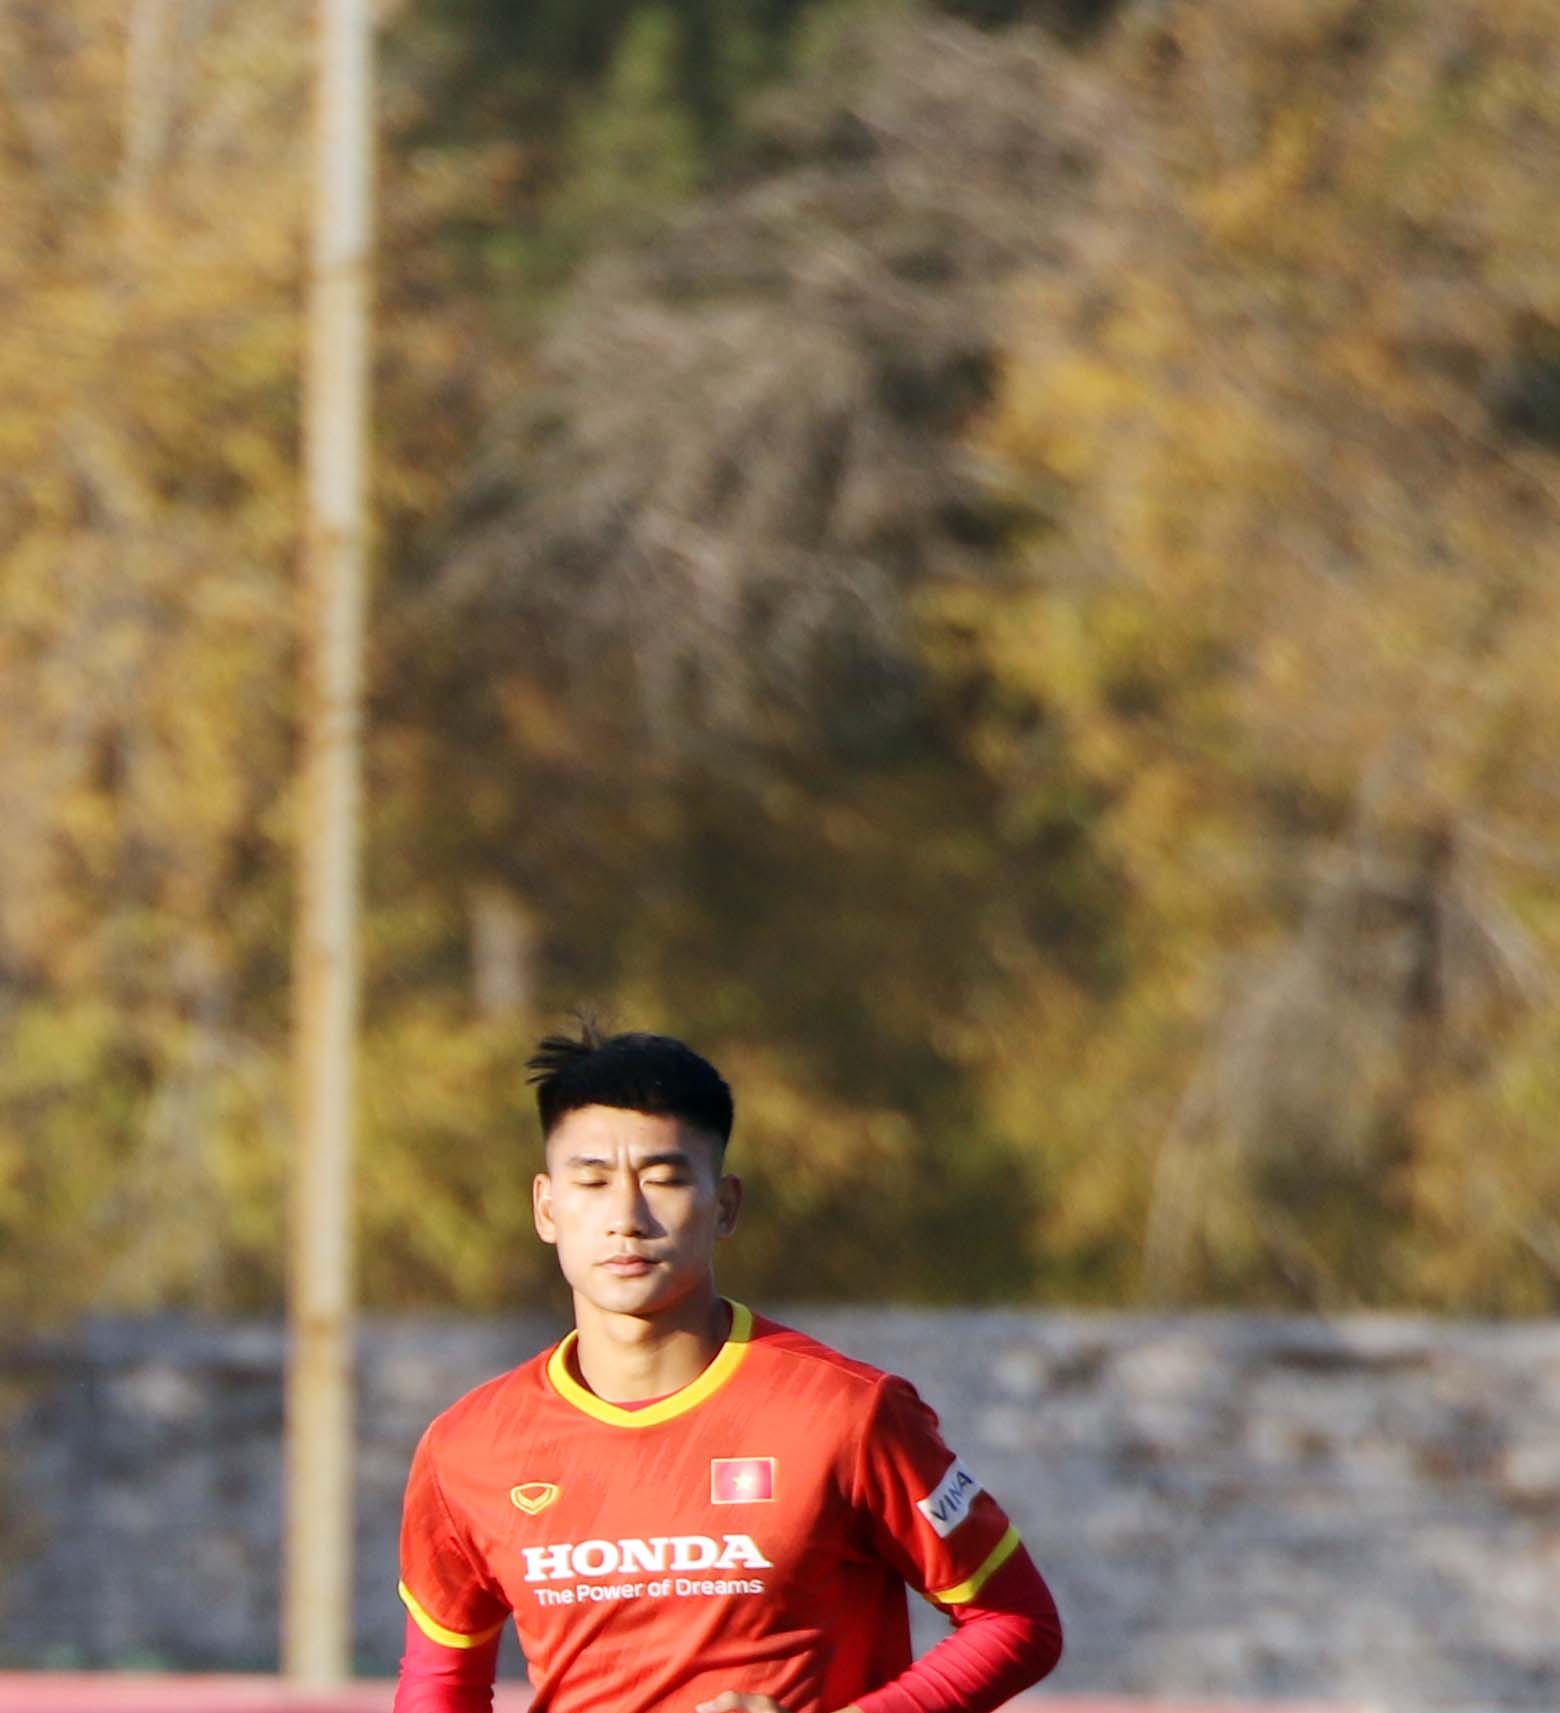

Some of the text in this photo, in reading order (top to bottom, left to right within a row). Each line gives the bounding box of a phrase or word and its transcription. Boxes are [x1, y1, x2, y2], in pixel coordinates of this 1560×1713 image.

[521, 1534, 773, 1581] HONDA
[533, 1577, 766, 1606] The Power of Dreams
